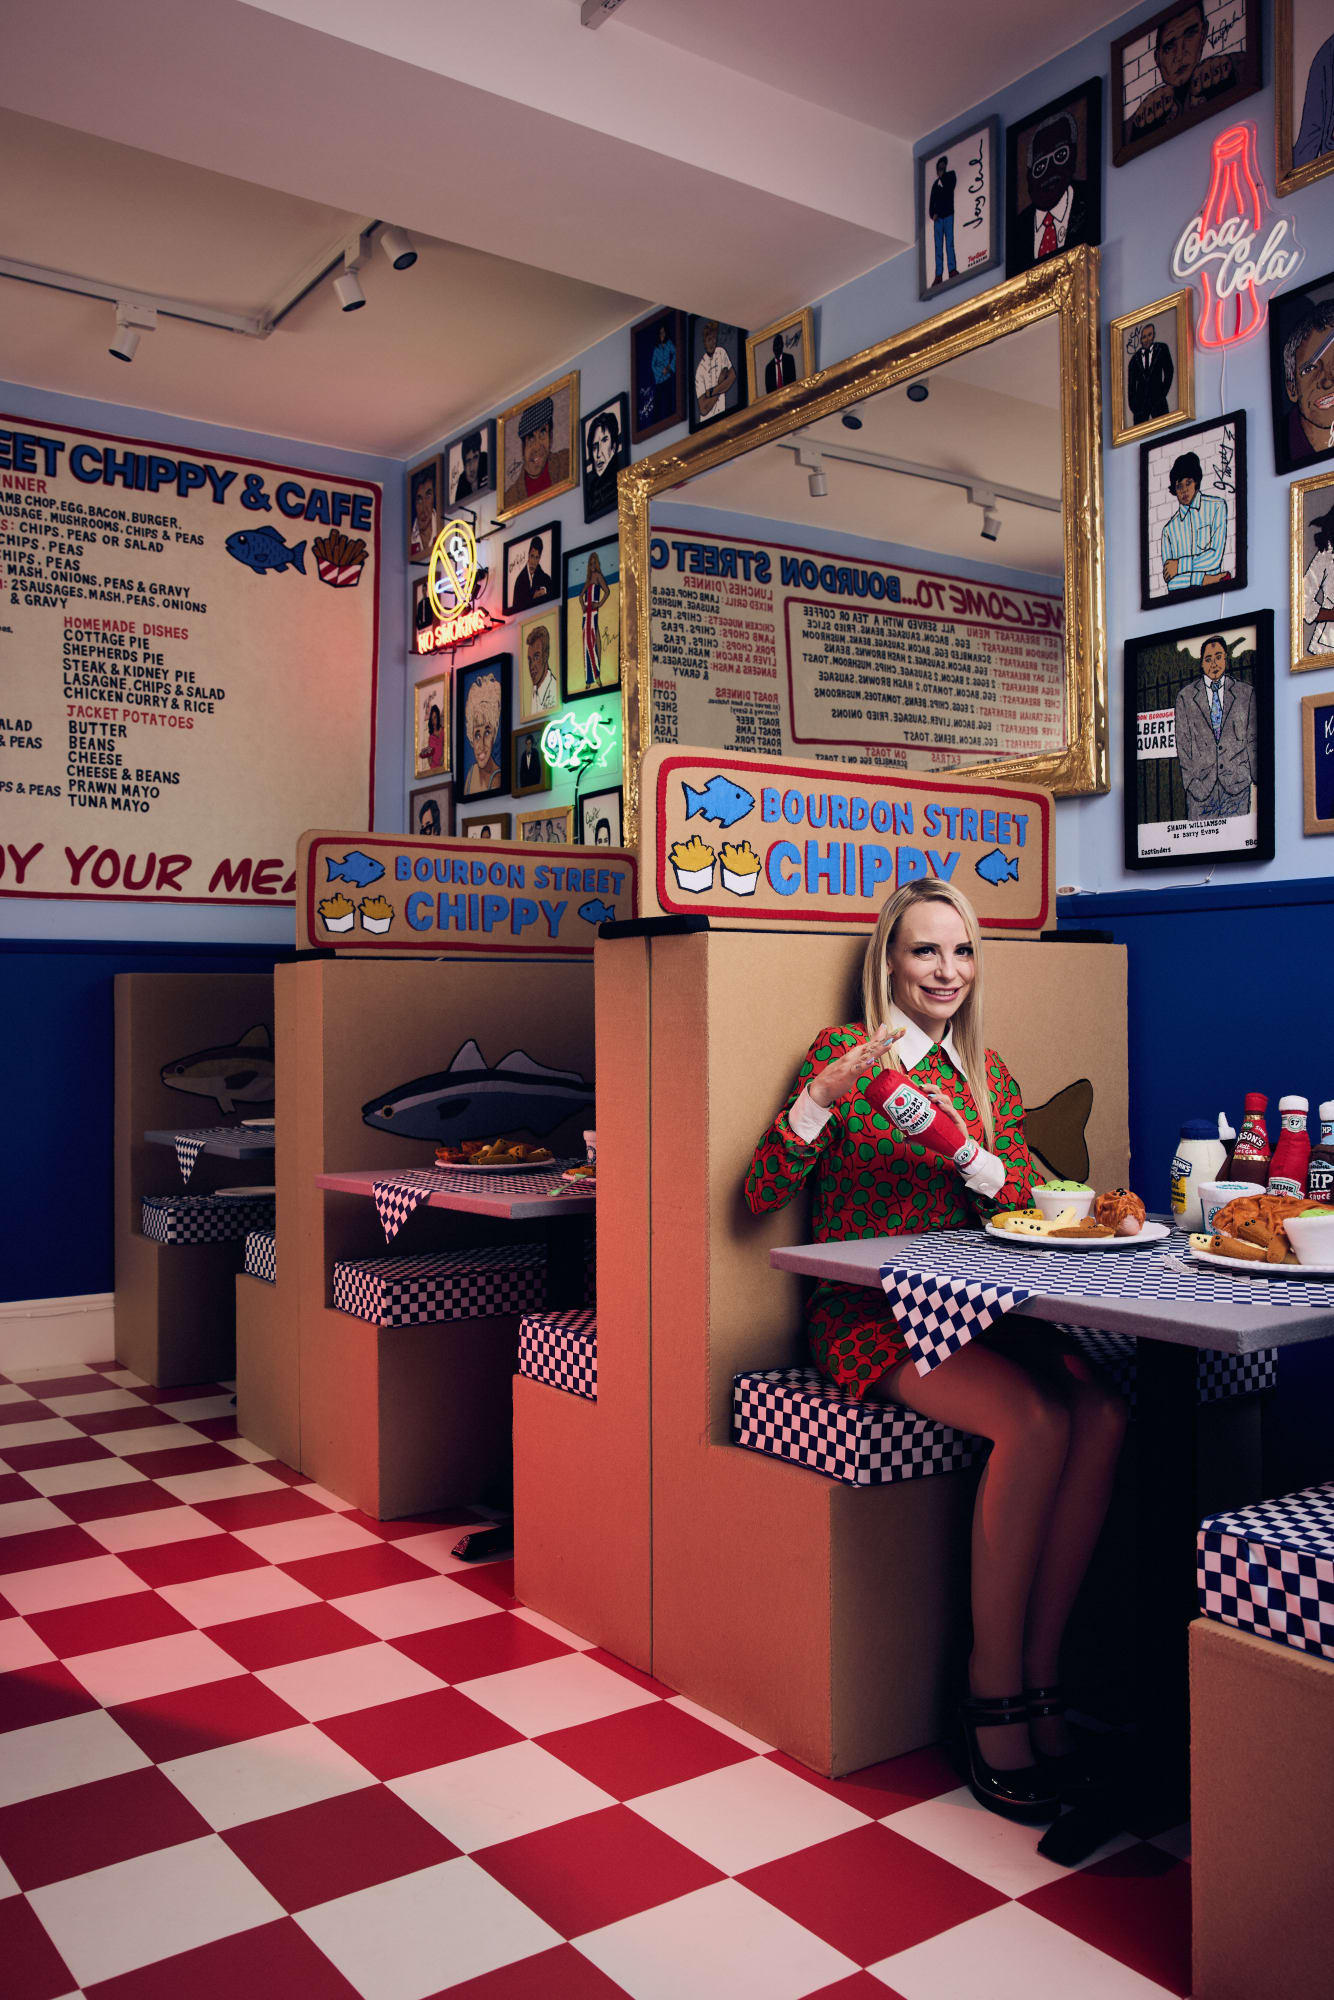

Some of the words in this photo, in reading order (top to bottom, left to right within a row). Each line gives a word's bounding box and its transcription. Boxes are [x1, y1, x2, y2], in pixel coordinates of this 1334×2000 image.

[1173, 216, 1249, 278] Coca
[1216, 219, 1299, 298] Cola
[69, 444, 238, 505] CHIPPY
[240, 473, 272, 512] &
[276, 481, 374, 532] CAFE
[67, 528, 97, 543] PEAS
[102, 535, 119, 546] OR
[124, 538, 164, 553] SALAD
[125, 525, 158, 540] CHIPS
[162, 530, 171, 541] &
[175, 532, 204, 546] PEAS
[48, 541, 84, 556] PEAS
[46, 556, 80, 571] PEAS
[104, 576, 134, 591] PEAS
[136, 581, 146, 593] &
[149, 582, 190, 598] GRAVY
[10, 592, 20, 605] &
[24, 594, 68, 609] GRAVY
[162, 598, 207, 614] ONIONS
[63, 616, 136, 634] HOMEMADE
[142, 623, 188, 640] DISHES
[417, 630, 434, 654] NO
[435, 610, 486, 647] SMOKING
[63, 629, 125, 646] COTTAGE
[129, 636, 150, 650] PIE
[62, 643, 138, 662] SHEPHERDS
[143, 652, 164, 666] PIE
[62, 658, 107, 674] STEAK
[110, 663, 120, 676] &
[123, 664, 169, 680] KIDNEY
[175, 670, 196, 684] PIE
[133, 679, 172, 695] CHIPS
[175, 684, 184, 696] &
[186, 686, 225, 700] SALAD
[63, 687, 123, 703] CHICKEN
[126, 692, 168, 708] CURRY
[171, 698, 179, 710] &
[184, 700, 215, 714] RICE
[66, 704, 119, 721] JACKET
[123, 709, 194, 730] POTATOES
[68, 720, 128, 738] BUTTER
[9, 735, 43, 749] PEAS
[68, 736, 116, 752] BEANS
[68, 750, 123, 766] CHEESE
[66, 765, 118, 780] CHEESE
[121, 768, 132, 781] &
[135, 769, 181, 785] BEANS
[16, 782, 26, 794] &
[29, 783, 62, 797] PEAS
[68, 779, 117, 795] PRAWN
[121, 784, 160, 799] MAYO
[67, 793, 108, 809] TUNA
[111, 797, 150, 813] MAYO
[760, 787, 915, 836] BOURDON
[922, 803, 1030, 847] STREET
[1167, 823, 1187, 832] SHAUN
[1188, 819, 1227, 829] WILLIAMSON
[1200, 828, 1220, 836] Evans
[64, 844, 193, 892] YOUR
[394, 855, 526, 889] BOURDON
[533, 864, 626, 896] STREET
[404, 891, 569, 938] CHIPPY
[897, 1097, 919, 1121] KETCHUP
[900, 1101, 923, 1125] TOMATO
[910, 1111, 929, 1130] HEINZ
[1321, 1125, 1333, 1134] HP
[960, 1151, 969, 1160] 57
[1270, 1182, 1294, 1193] HEINZ
[1310, 1173, 1334, 1189] HP
[1309, 1191, 1331, 1201] SAUCE
